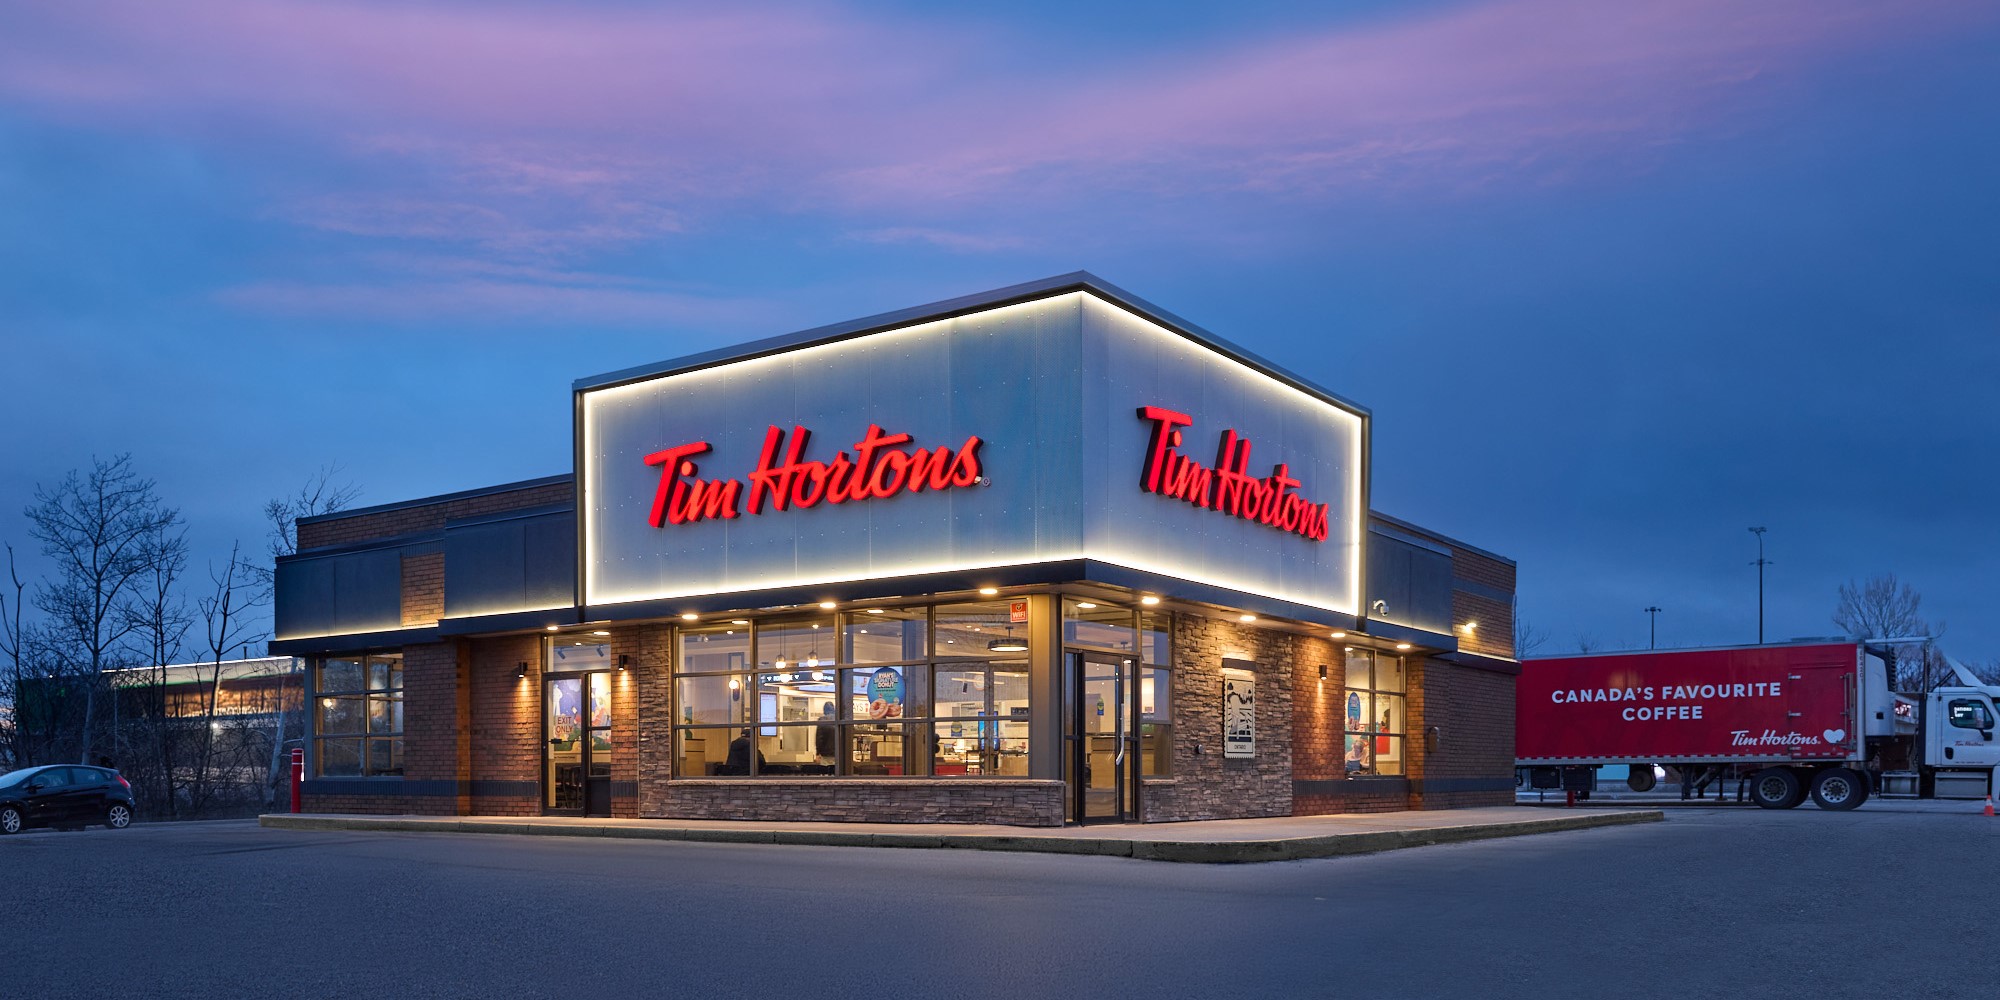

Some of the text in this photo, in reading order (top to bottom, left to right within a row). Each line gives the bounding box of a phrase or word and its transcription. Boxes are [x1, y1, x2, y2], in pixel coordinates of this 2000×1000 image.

[643, 424, 984, 528] Tim Hortons
[1137, 405, 1330, 543] Tim Hortons
[1551, 682, 1781, 704] CANADA'S FAVOURITE
[557, 716, 572, 724] EXIT
[1622, 705, 1703, 721] COFFEE
[1731, 729, 1818, 746] Tim Hortons
